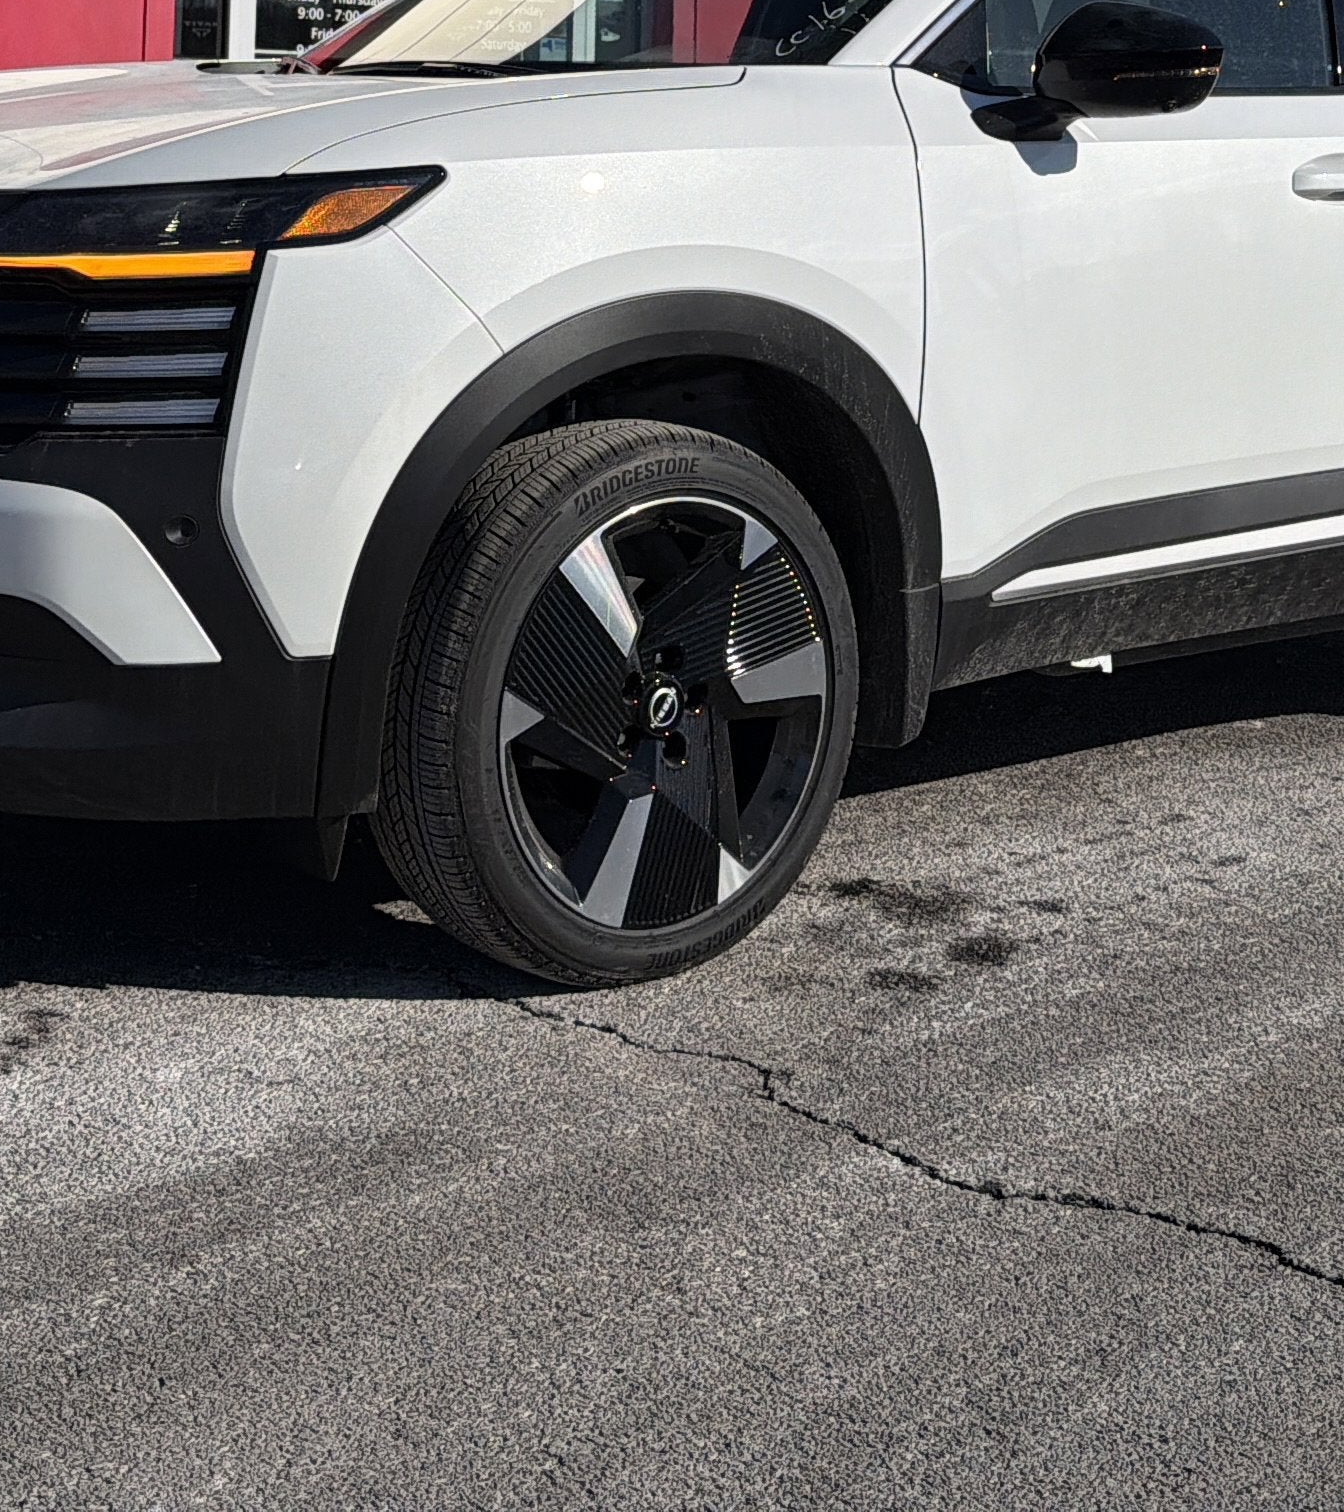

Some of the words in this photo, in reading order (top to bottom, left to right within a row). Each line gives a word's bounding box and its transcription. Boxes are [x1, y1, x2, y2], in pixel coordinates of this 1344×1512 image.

[297, 7, 324, 21] 9:00
[334, 8, 360, 22] 7:00
[311, 27, 334, 40] Frid
[574, 457, 700, 517] BRIDGESTONE
